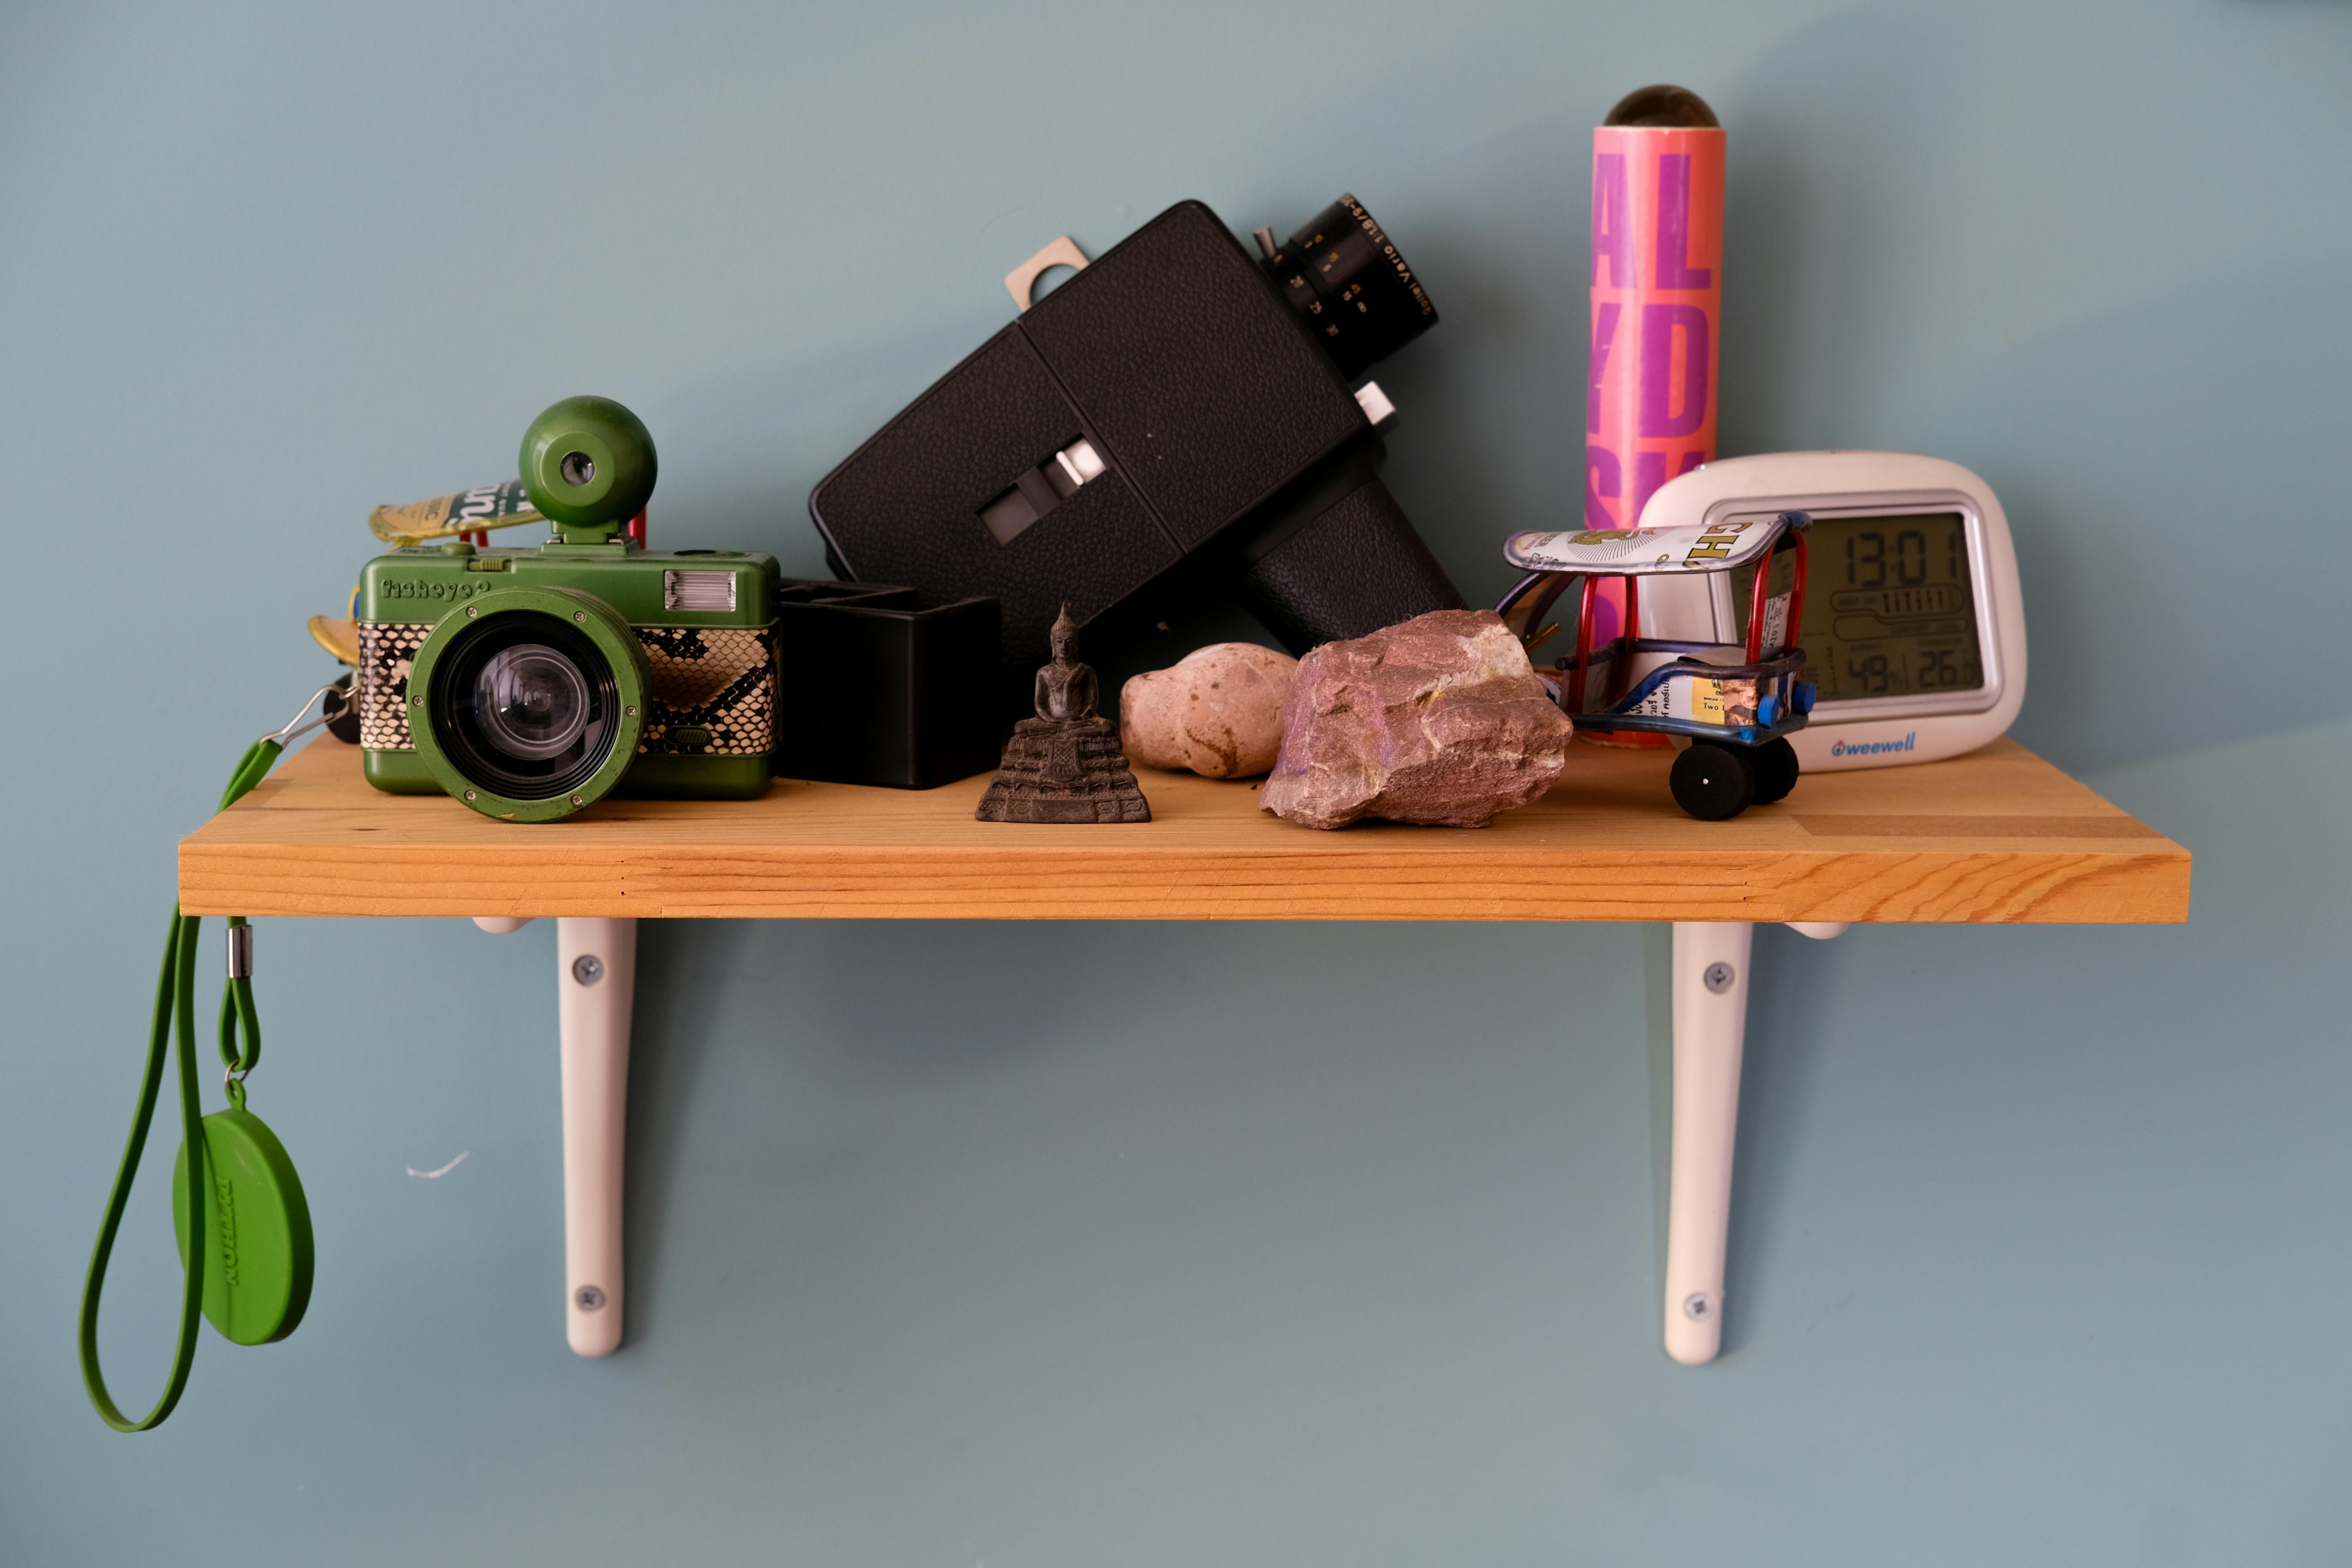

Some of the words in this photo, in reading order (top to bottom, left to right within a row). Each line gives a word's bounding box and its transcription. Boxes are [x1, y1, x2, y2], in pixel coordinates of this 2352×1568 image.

[1384, 245, 1410, 283] Vario
[380, 579, 473, 602] fisheye
[1703, 702, 1719, 710] Two
[1846, 730, 1917, 756] weewell
